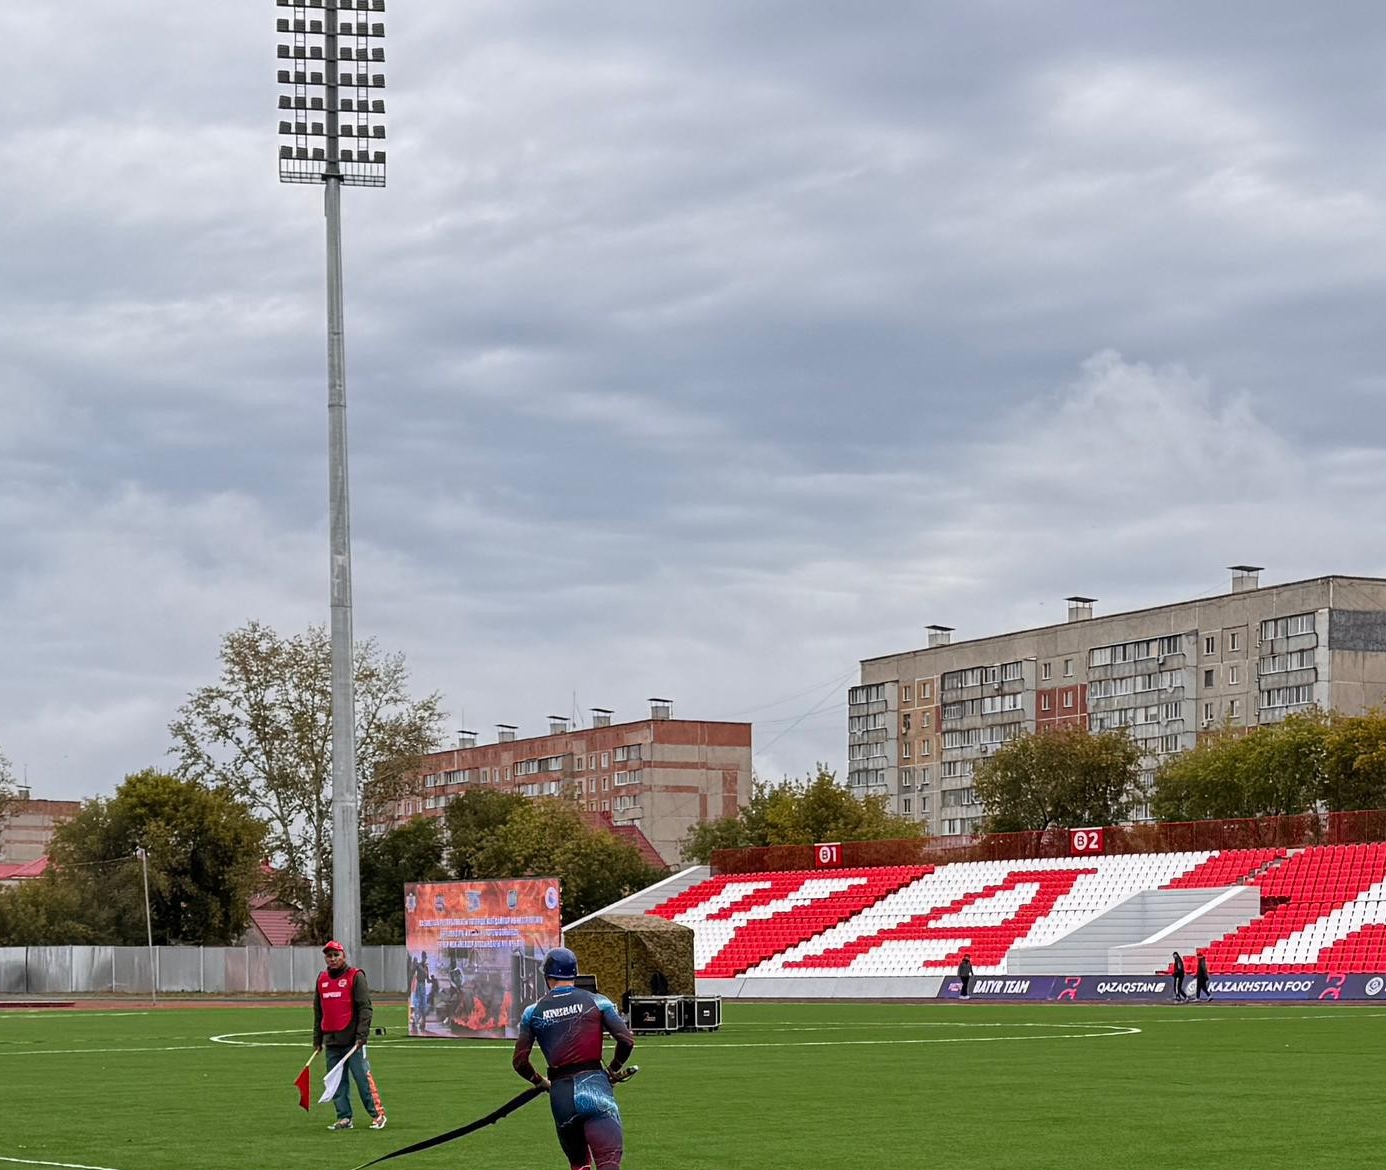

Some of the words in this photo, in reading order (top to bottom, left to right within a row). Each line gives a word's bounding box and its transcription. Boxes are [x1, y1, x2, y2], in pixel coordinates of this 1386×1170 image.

[973, 980, 1001, 993] BATYR
[1003, 980, 1030, 993] TEAM
[1097, 982, 1156, 993] QAZAQSTAN
[1208, 981, 1283, 992] KAZAKHSTAN
[1284, 981, 1315, 992] FOO
